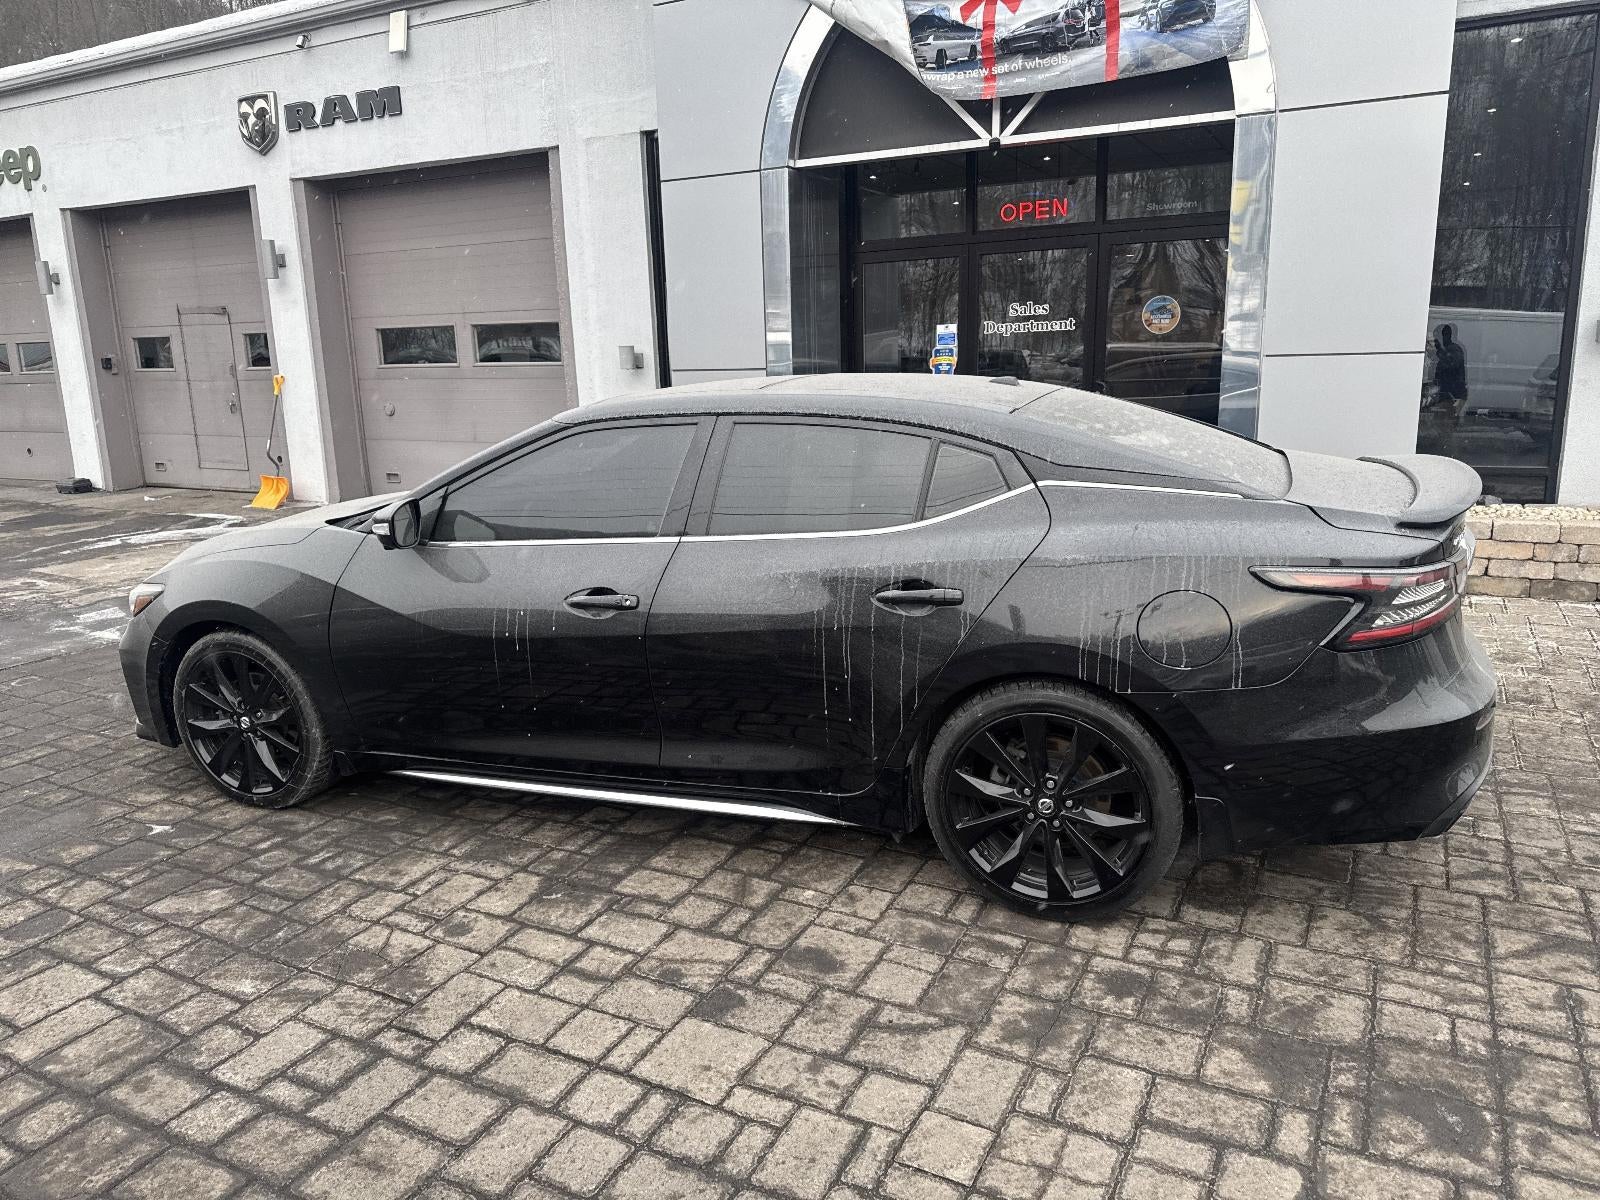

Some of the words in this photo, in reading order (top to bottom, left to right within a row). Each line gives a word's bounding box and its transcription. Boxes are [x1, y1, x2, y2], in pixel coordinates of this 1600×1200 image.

[957, 71, 965, 79] a
[966, 67, 990, 79] new
[991, 62, 1010, 75] set
[1011, 59, 1025, 72] of
[1025, 52, 1072, 69] wheels.
[283, 85, 403, 132] RAM
[0, 145, 42, 192] ep
[1000, 198, 1068, 222] OPEN
[1146, 200, 1198, 211] Showroom
[1009, 301, 1050, 316] Sales
[983, 317, 1076, 337] Department
